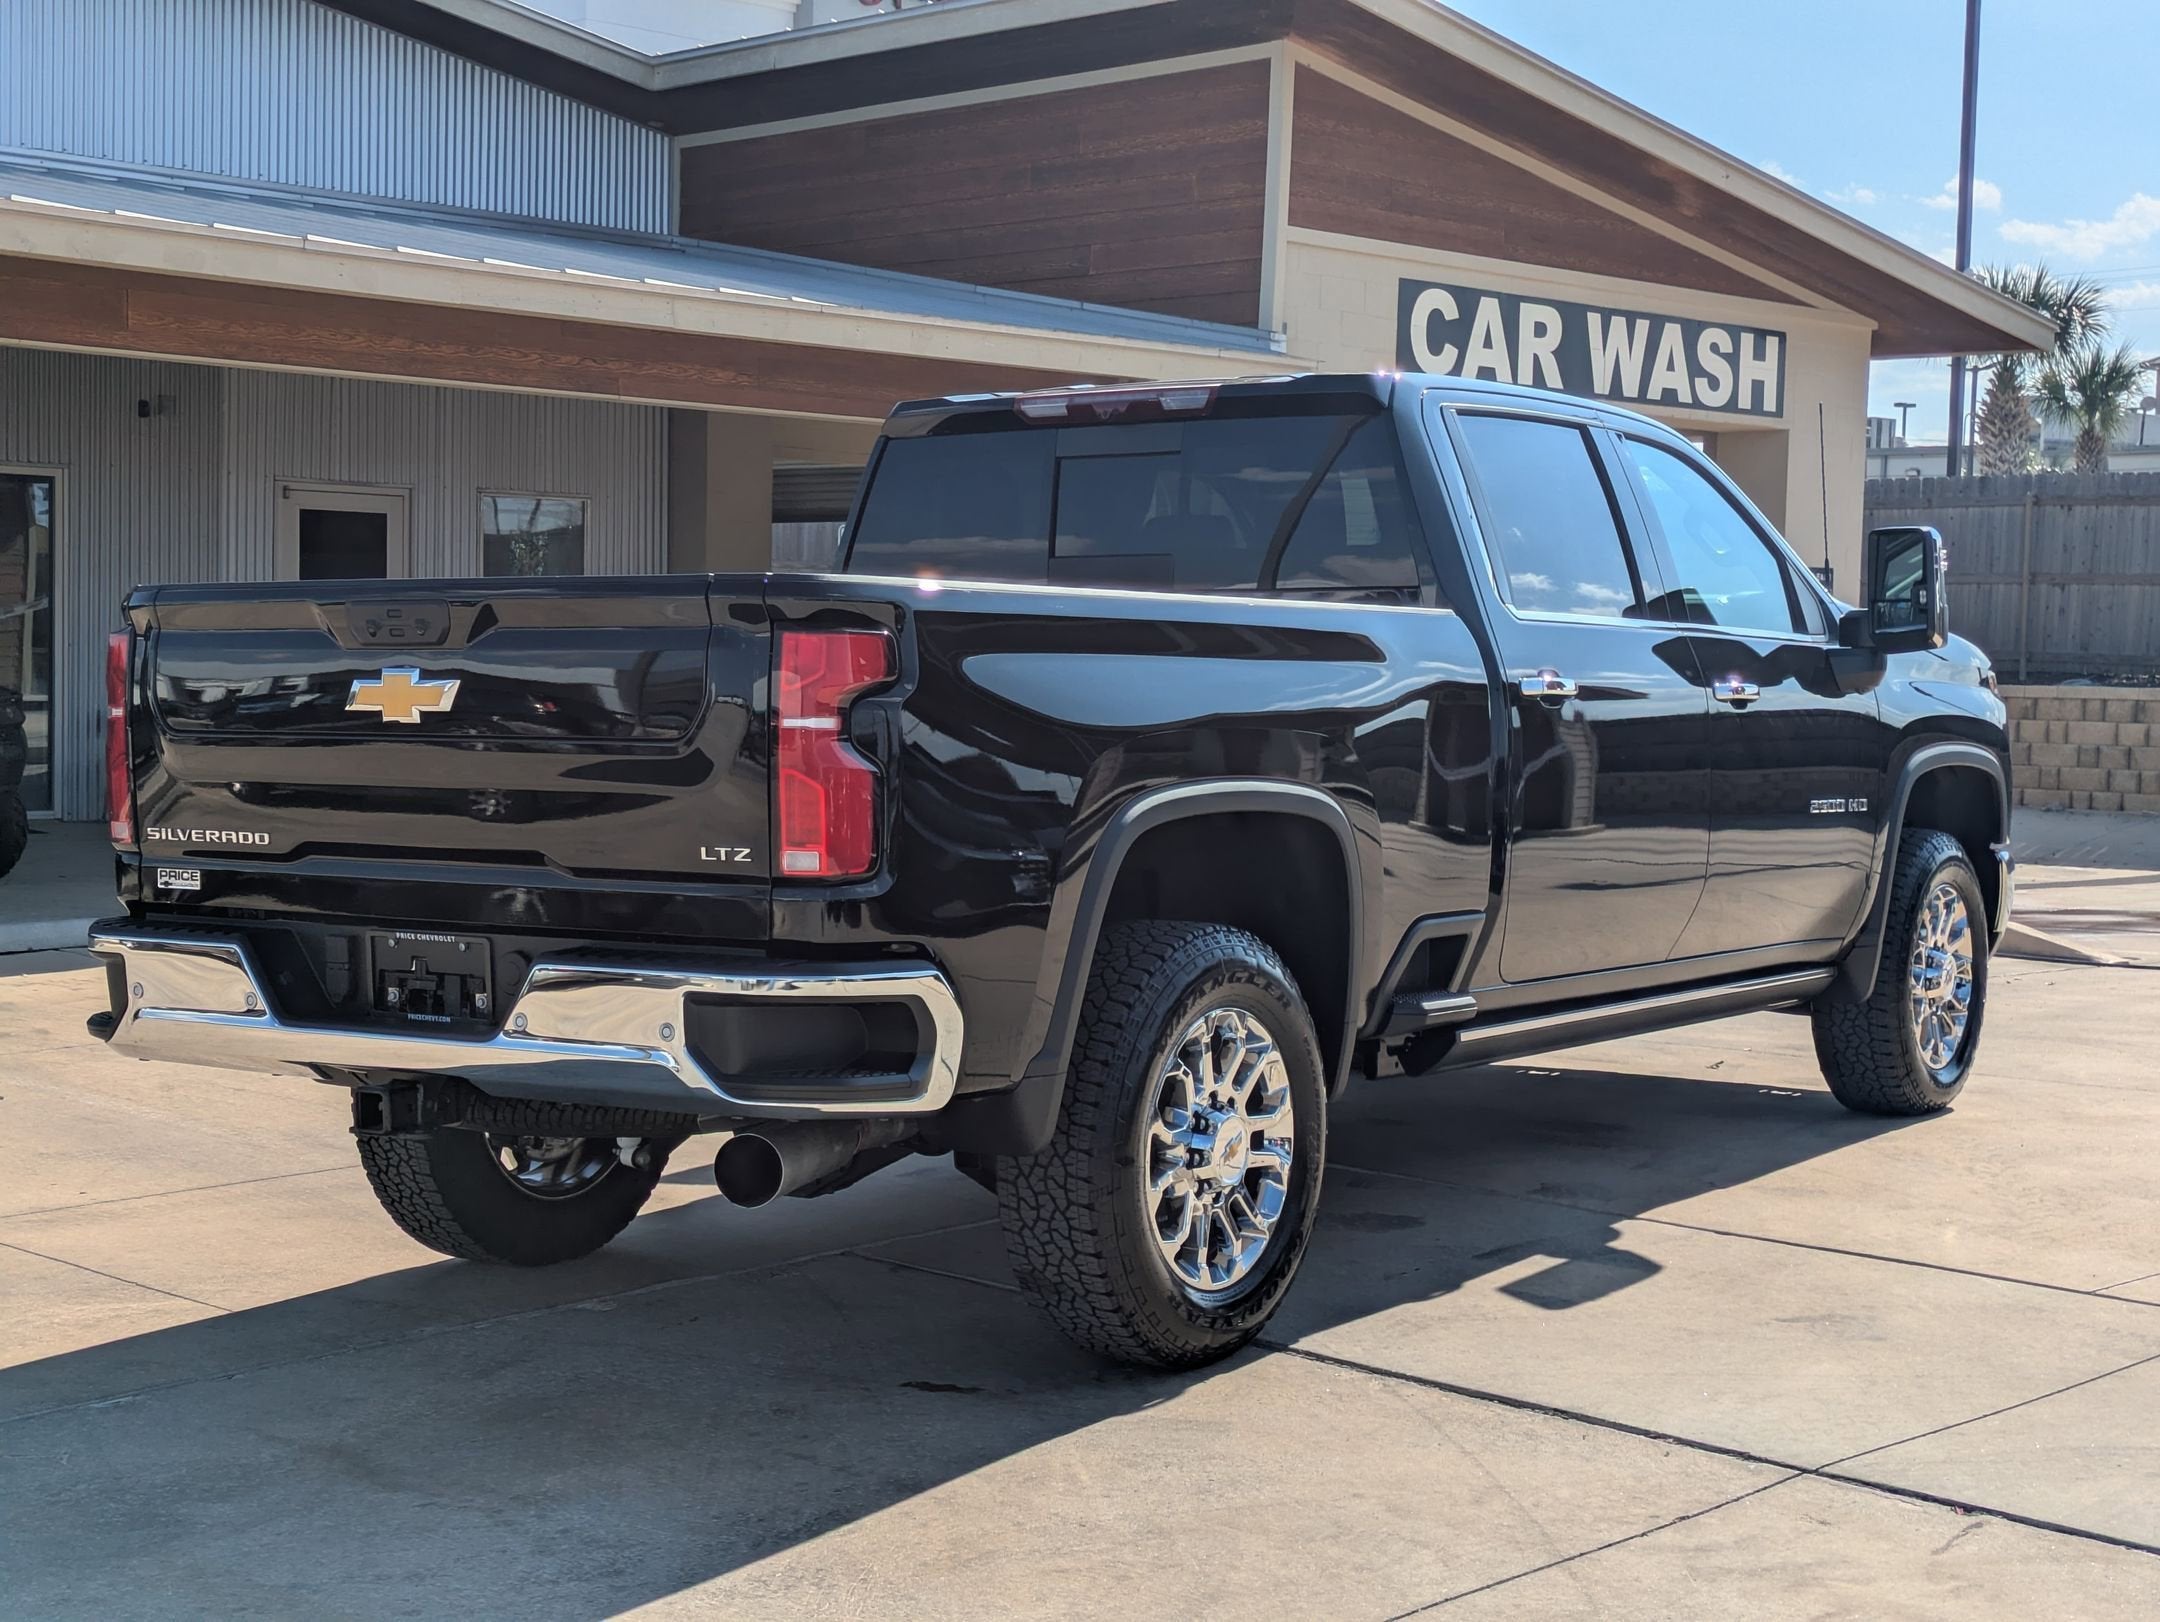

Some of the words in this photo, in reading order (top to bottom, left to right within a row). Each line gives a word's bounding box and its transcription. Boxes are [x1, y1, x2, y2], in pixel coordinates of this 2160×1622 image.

[1410, 288, 1564, 390] CAR
[1586, 311, 1780, 413] WASH
[1810, 799, 1846, 814] 2500
[1848, 798, 1868, 812] HD
[146, 827, 270, 845] SILVERADO
[700, 846, 752, 862] LTZ
[159, 869, 200, 881] PRICE
[396, 932, 415, 940] PRICE
[416, 933, 456, 943] CHEVROLET
[1157, 968, 1292, 1055] WRANGLER
